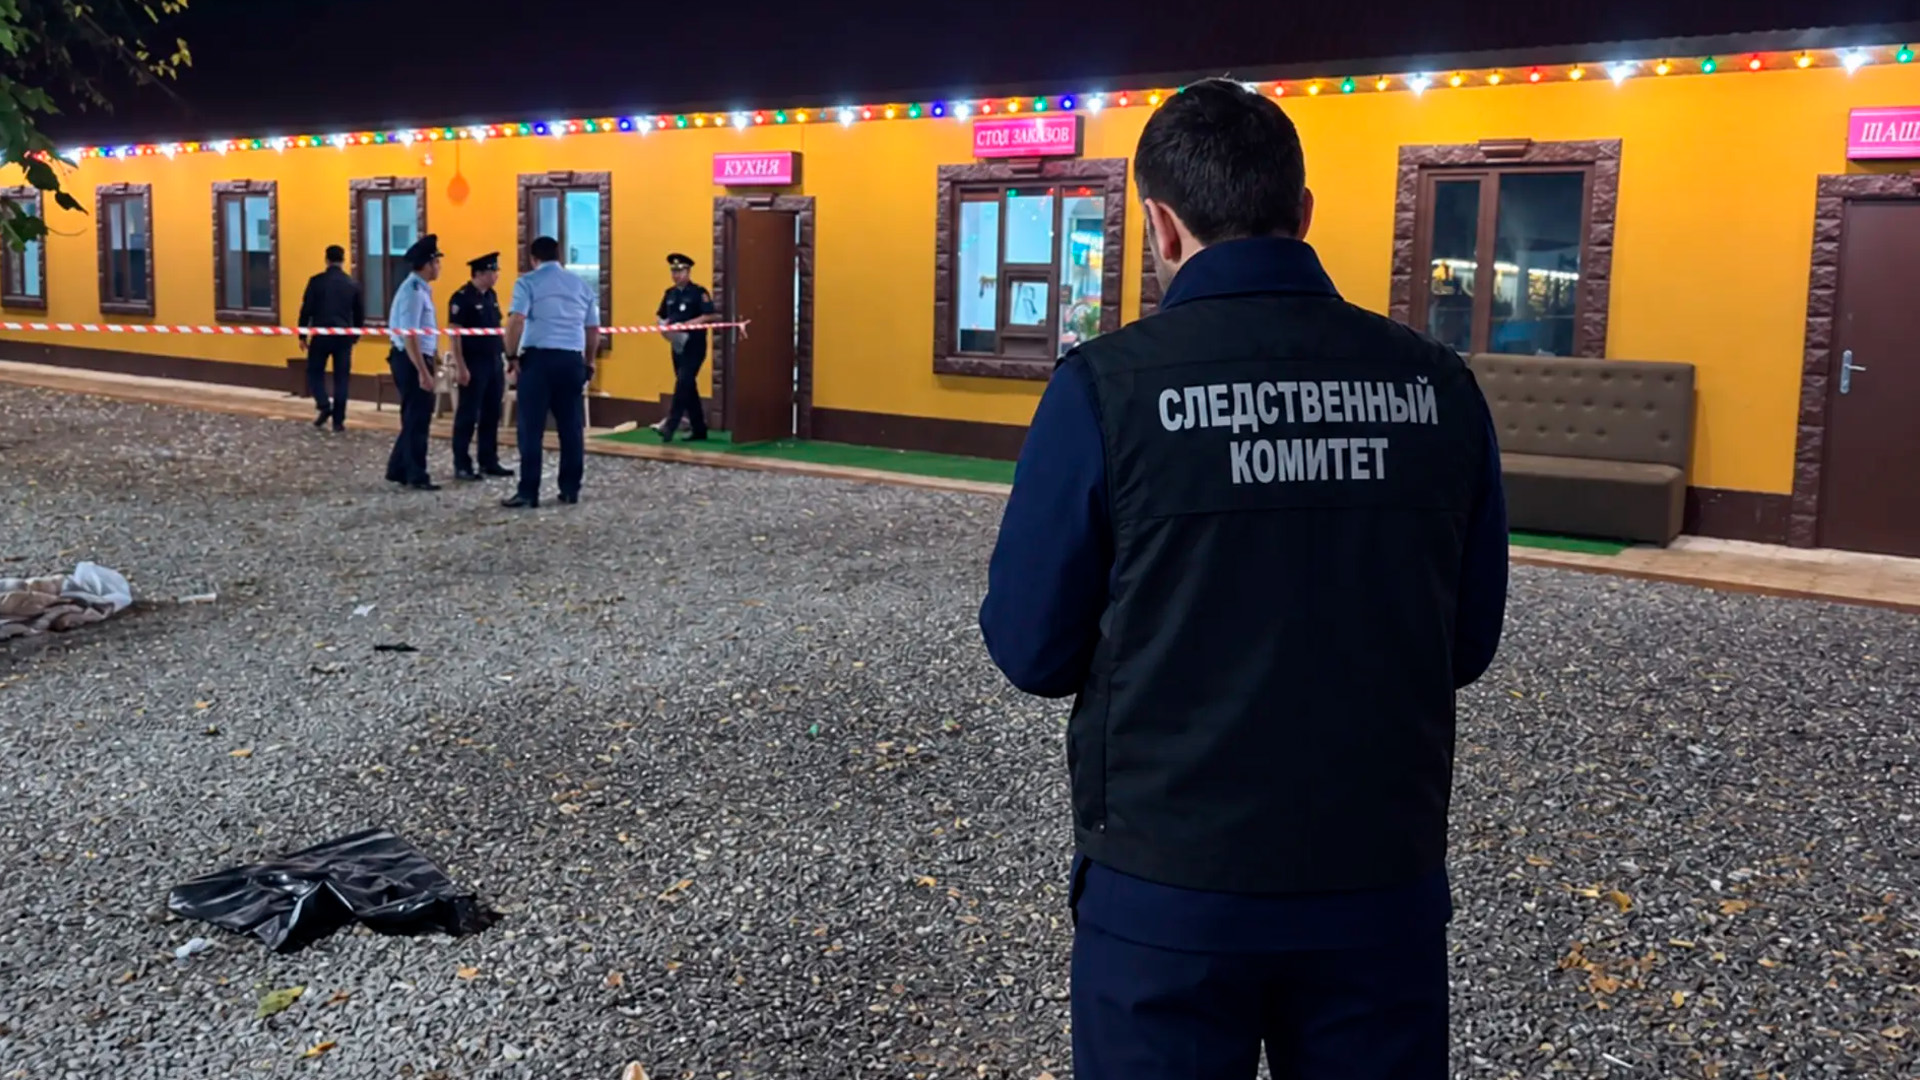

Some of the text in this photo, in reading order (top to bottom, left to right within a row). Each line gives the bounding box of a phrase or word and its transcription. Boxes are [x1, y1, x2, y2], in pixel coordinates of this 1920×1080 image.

[976, 126, 1070, 146] СТОЛ ЗАКАЗОВ
[724, 159, 779, 176] КУХНЯ
[1158, 375, 1438, 433] СЛЕДСТВЕННЫЙ
[1230, 437, 1389, 484] КОМИТЕТ
